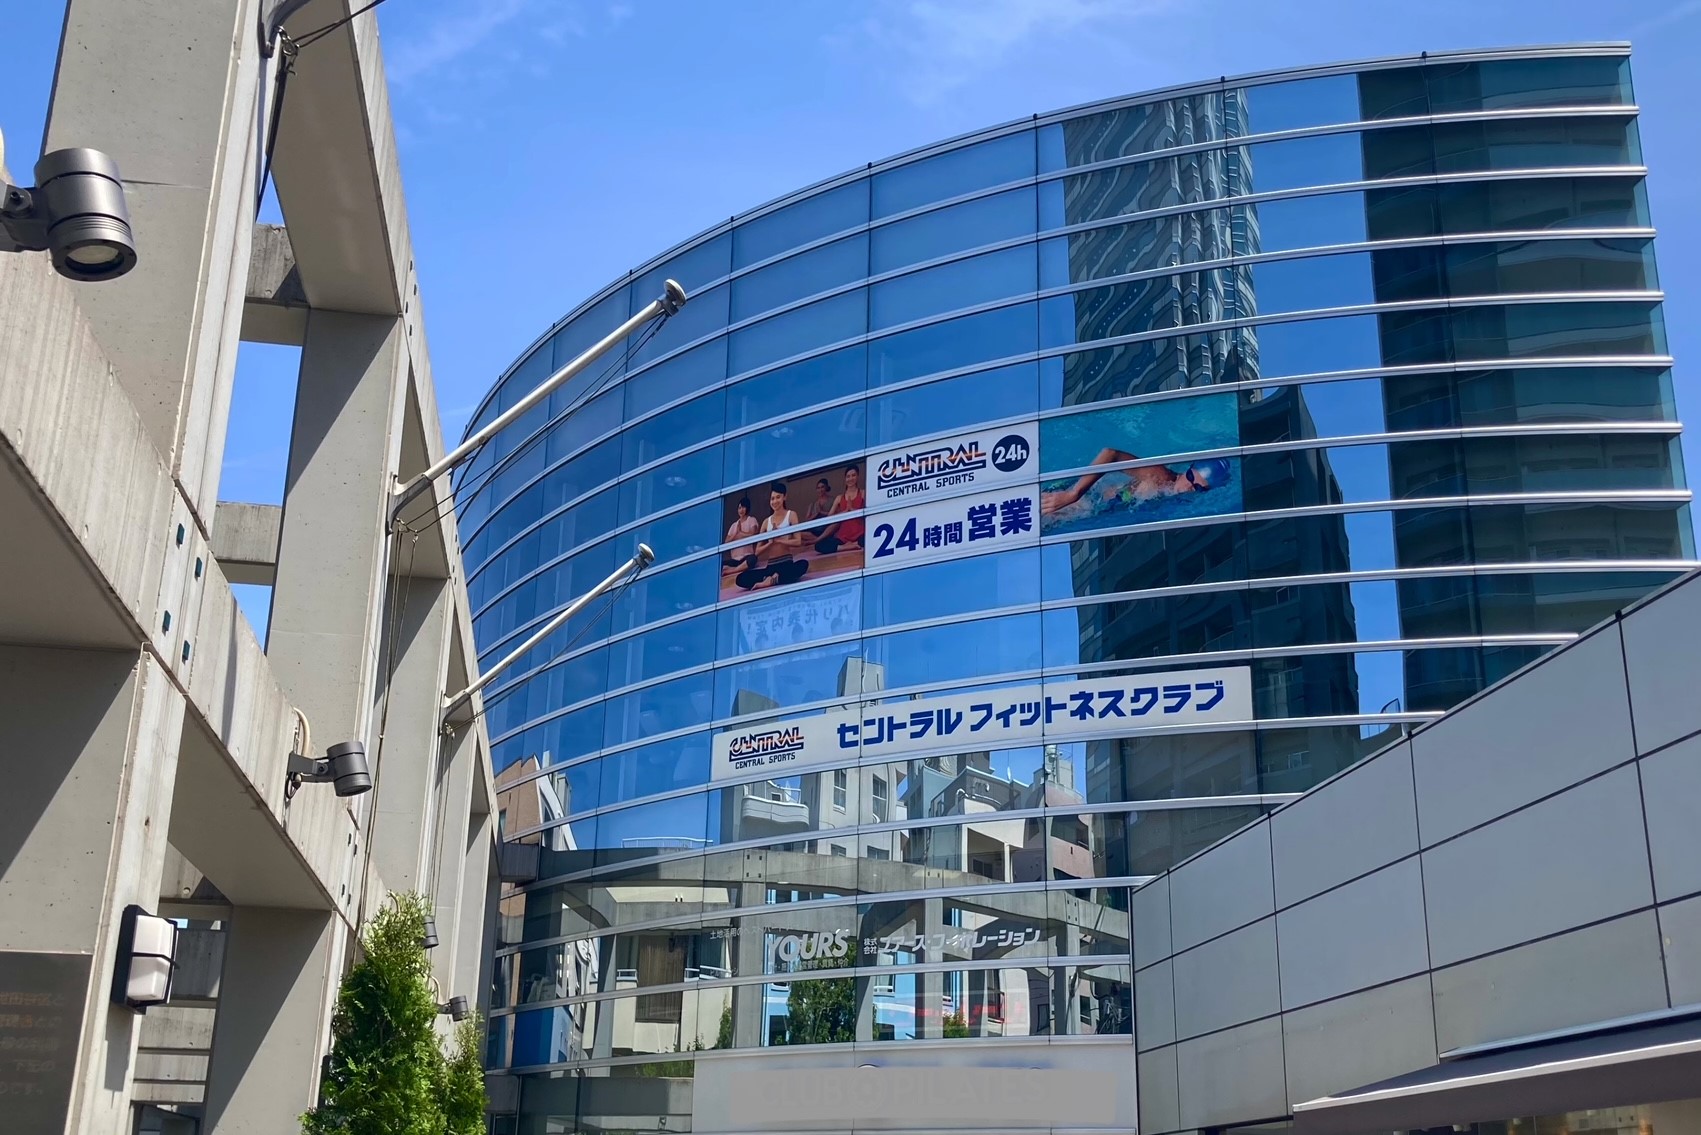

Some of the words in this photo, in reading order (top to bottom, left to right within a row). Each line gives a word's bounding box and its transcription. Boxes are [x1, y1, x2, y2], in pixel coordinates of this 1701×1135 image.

[877, 441, 986, 489] CENTRAL
[994, 444, 1027, 465] 24h
[887, 481, 930, 498] CENTRAL
[936, 472, 975, 488] SPORTS
[872, 497, 1032, 559] 24時間営業
[729, 727, 804, 762] CENTRAL
[735, 758, 765, 769] CENTRAL
[769, 752, 796, 764] SPORTS
[767, 929, 849, 962] YOURS
